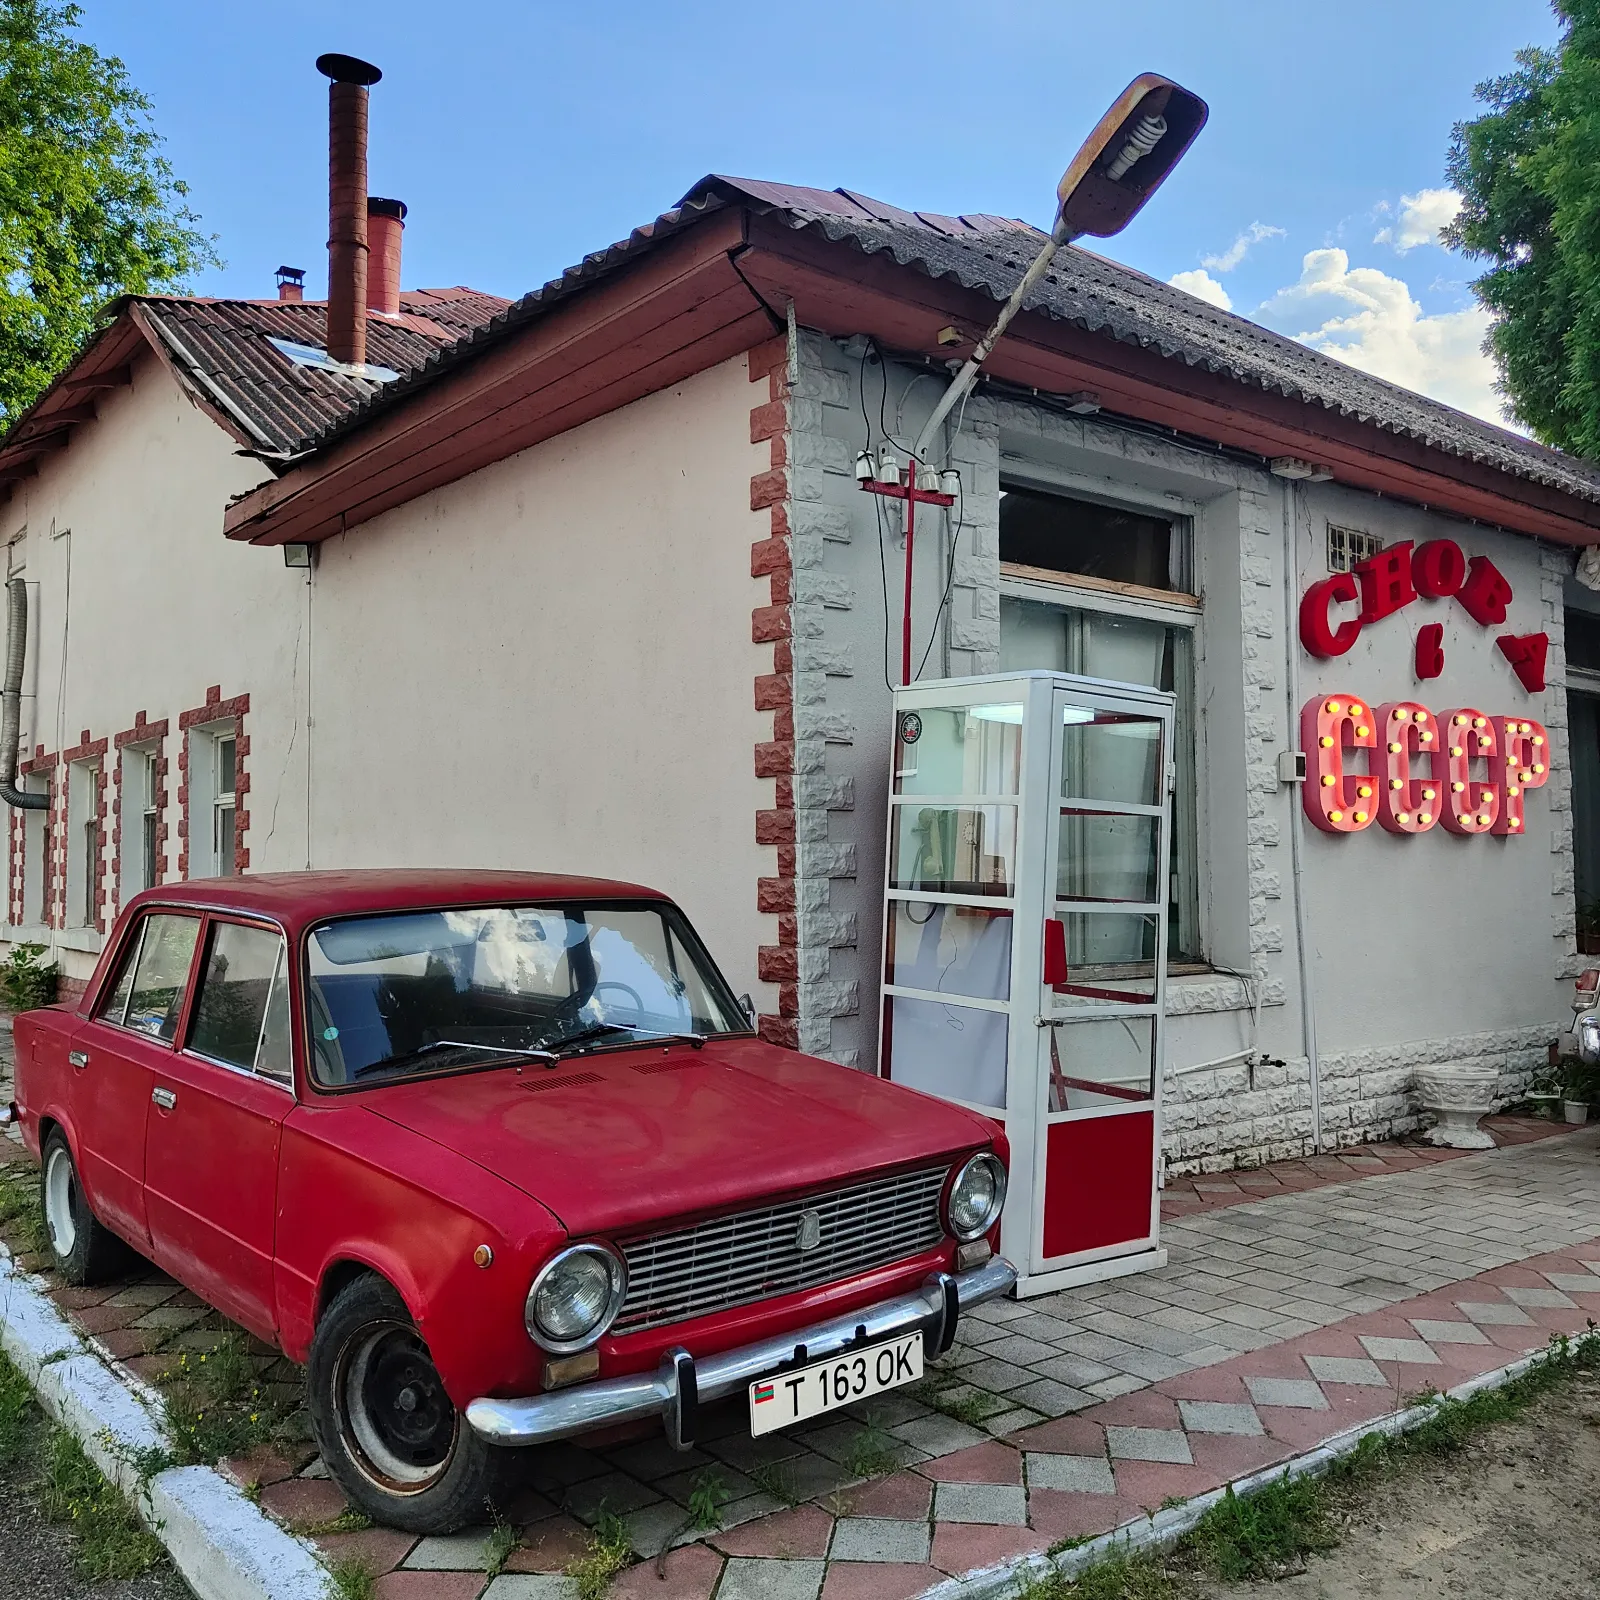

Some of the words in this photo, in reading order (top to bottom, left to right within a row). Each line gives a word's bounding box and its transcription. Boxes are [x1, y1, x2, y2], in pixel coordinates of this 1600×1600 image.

[1300, 539, 1549, 694] СНОВА
[1301, 693, 1550, 835] СССР
[785, 1376, 806, 1417] T
[818, 1357, 867, 1407] 163
[876, 1340, 914, 1386] OK
